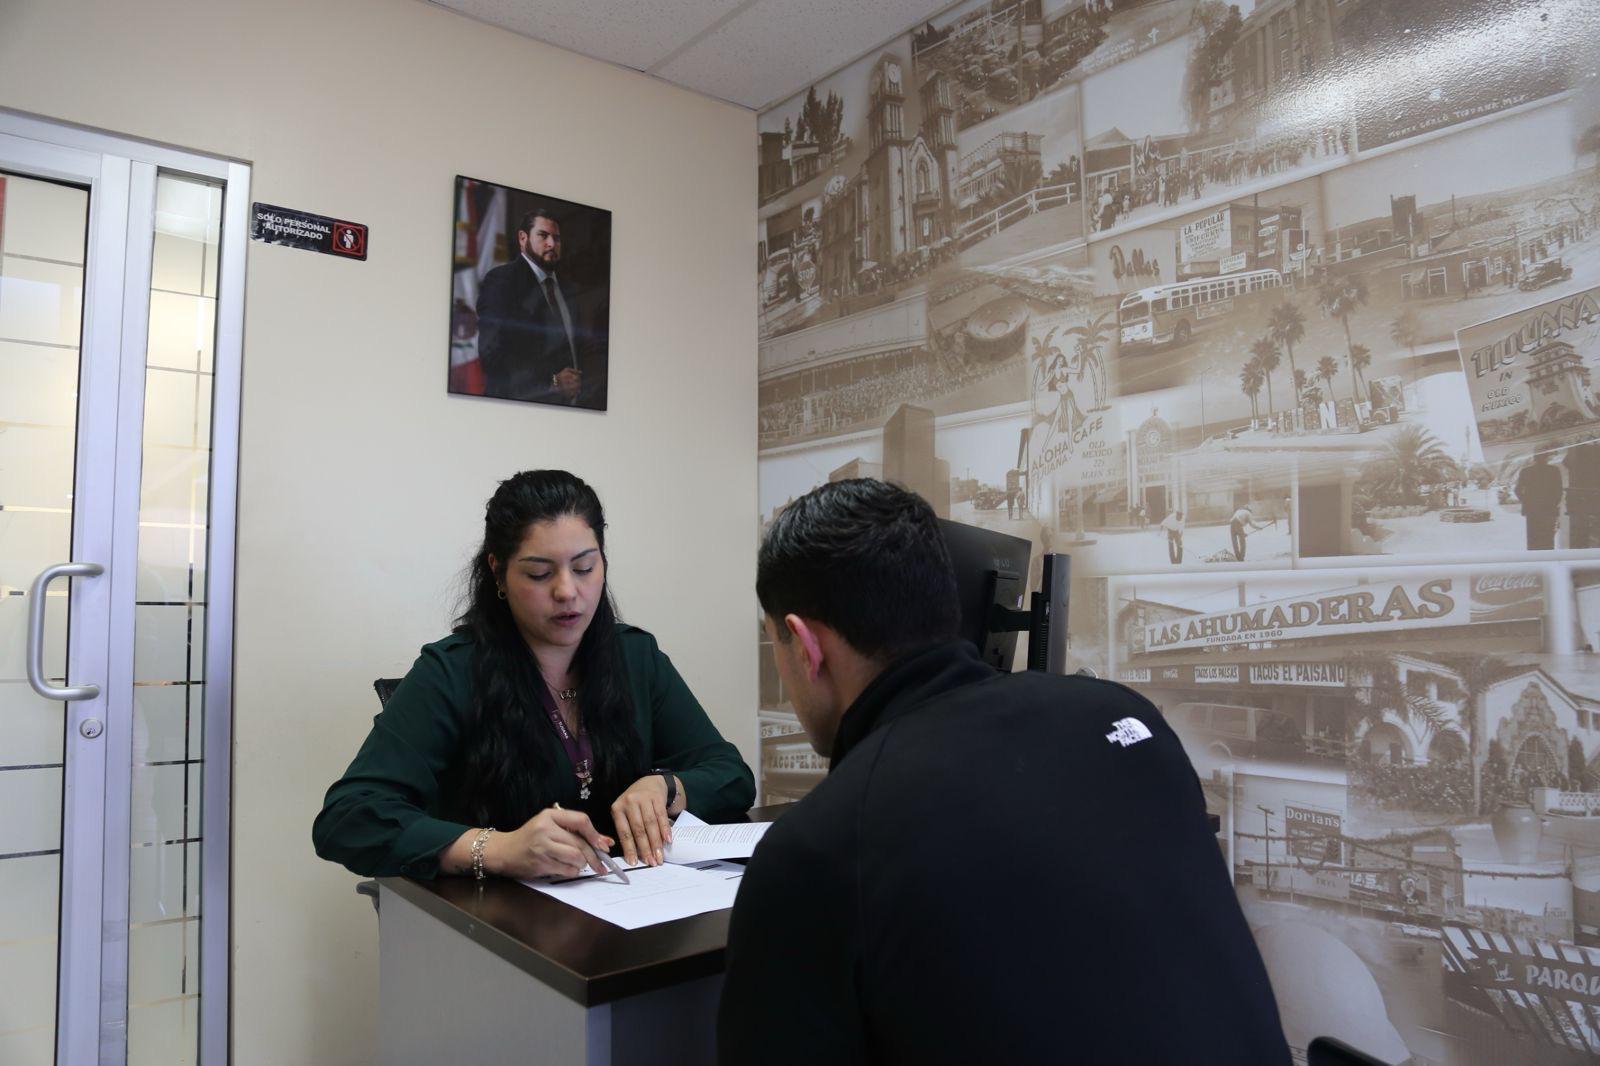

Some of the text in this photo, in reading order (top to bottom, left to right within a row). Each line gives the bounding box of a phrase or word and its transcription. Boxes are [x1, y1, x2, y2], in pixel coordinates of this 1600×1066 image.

[264, 222, 323, 240] AUTORIZADO
[284, 217, 331, 234] PERSONAL
[1110, 244, 1160, 280] Dallas
[798, 268, 815, 281] STOP
[1082, 448, 1112, 458] MEXICO
[1088, 440, 1105, 450] OLD
[1031, 441, 1069, 472] ALOHA
[1150, 579, 1454, 647] LAS AHUMADERAS
[1206, 629, 1283, 643] FUNDADA EN 1960
[1252, 664, 1344, 683] TACOS EL PAISANO
[1286, 806, 1340, 828] Dorian's
